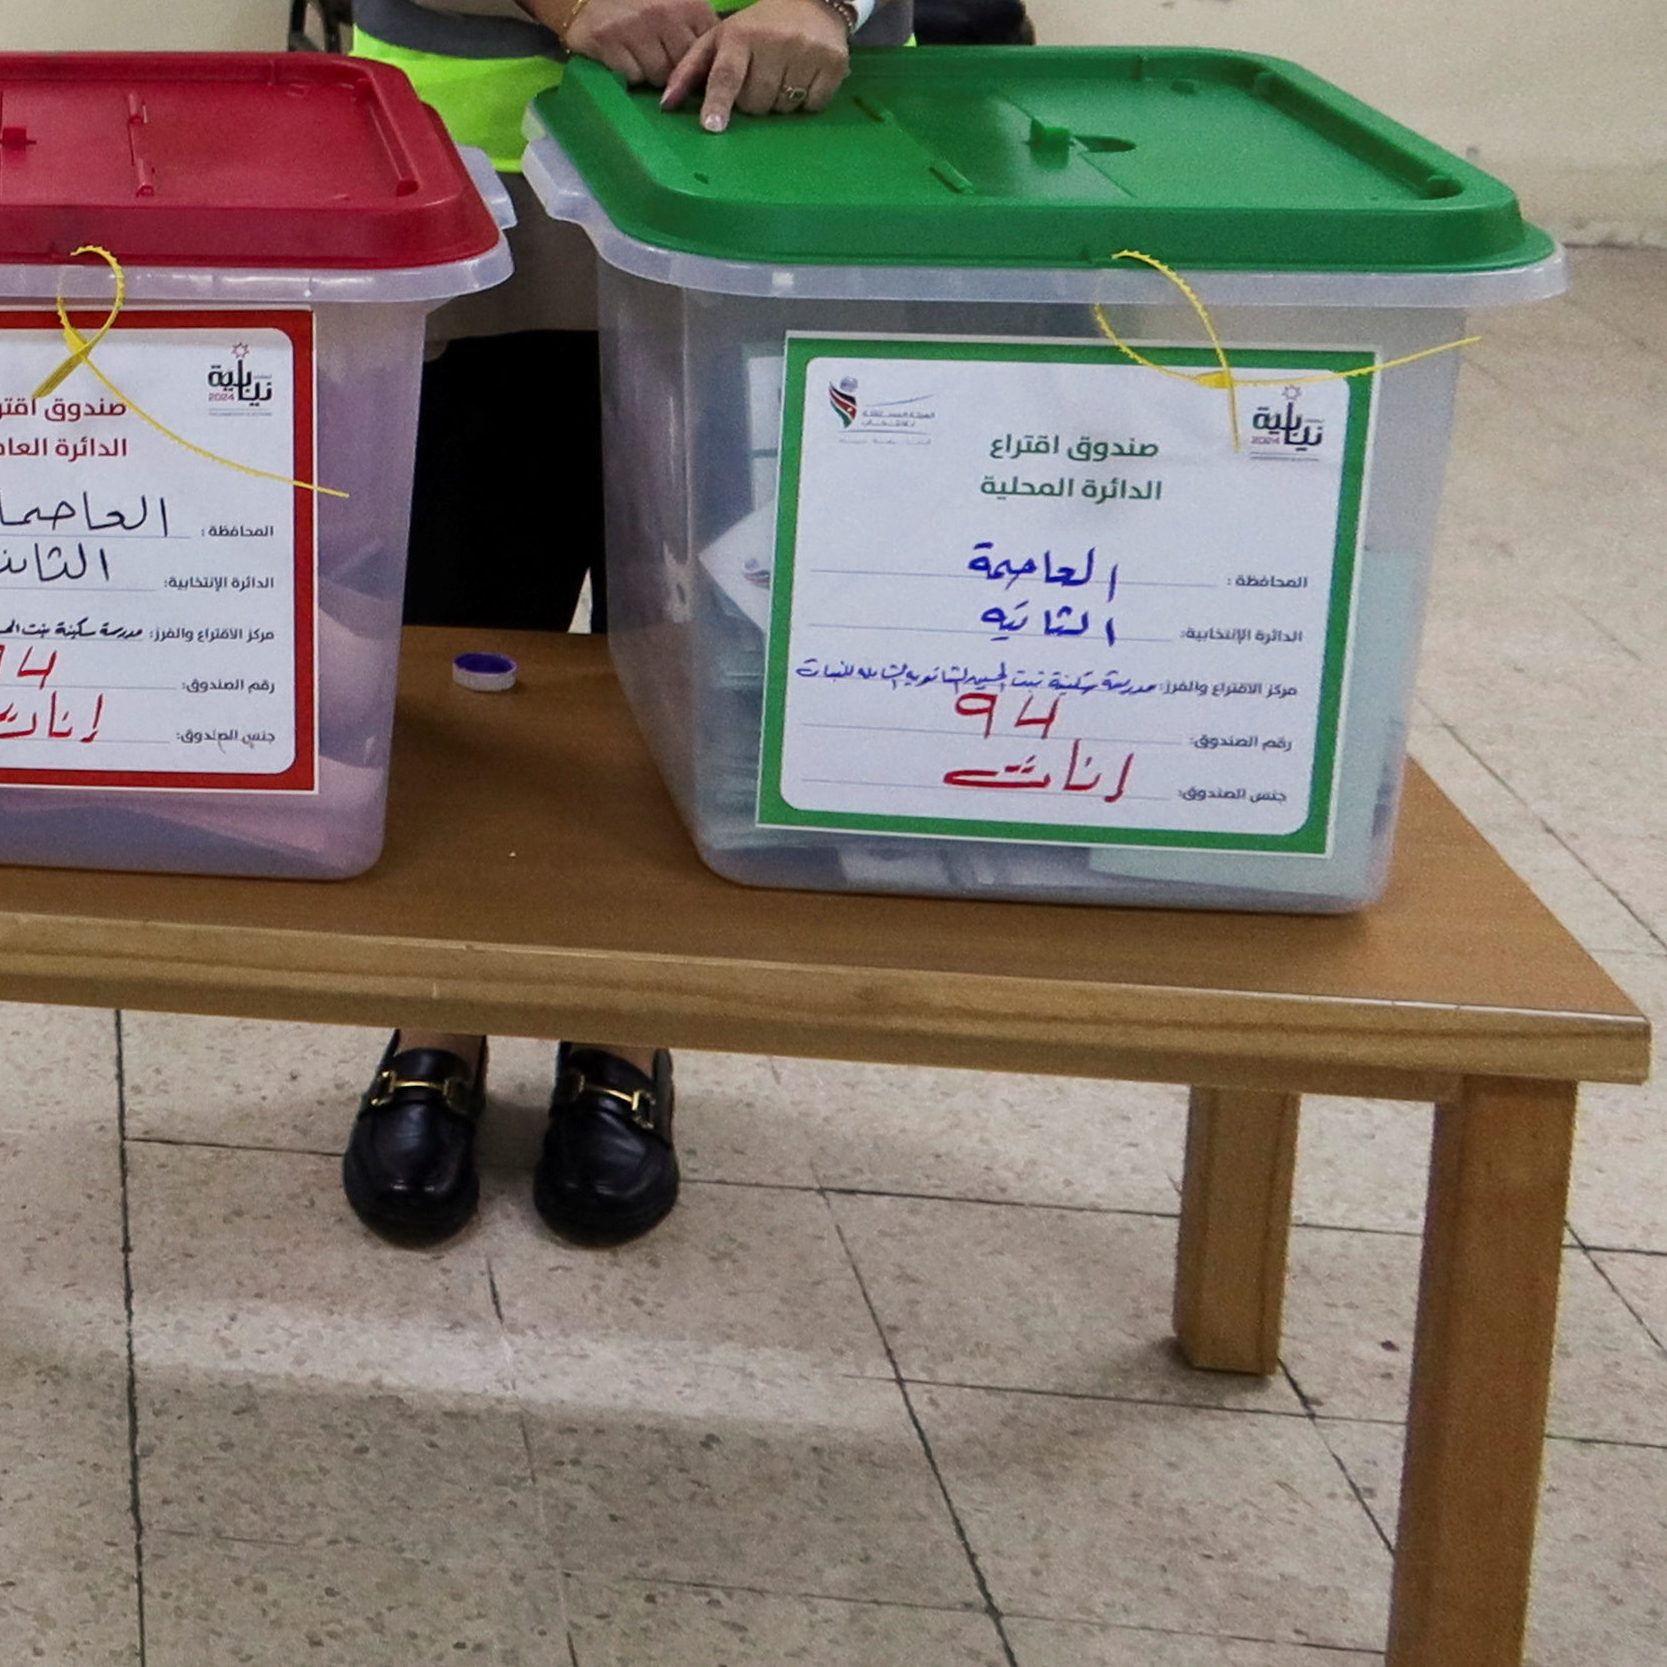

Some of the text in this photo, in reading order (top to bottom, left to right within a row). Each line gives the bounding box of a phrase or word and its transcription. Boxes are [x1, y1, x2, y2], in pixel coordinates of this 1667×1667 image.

[208, 392, 235, 402] 2024
[43, 397, 128, 423] صندوق
[55, 436, 128, 463] الدائرة
[989, 433, 1159, 463] صندوق اقتراع
[980, 475, 1162, 505] الدائرة المحلية
[230, 576, 275, 591] الدائرة
[22, 622, 51, 639] بنت
[55, 616, 98, 640] سكينة
[99, 621, 144, 639] مدرسة
[196, 627, 243, 643] الاقتراع
[245, 627, 275, 644] مركز
[1255, 627, 1304, 644] الدائرة
[181, 678, 276, 694] رقم الصندوق:
[1100, 669, 1157, 696] مدرسة
[1265, 679, 1298, 699] مركز
[954, 692, 1059, 740] 94
[246, 731, 276, 746] جنس
[1261, 737, 1293, 753] رقم
